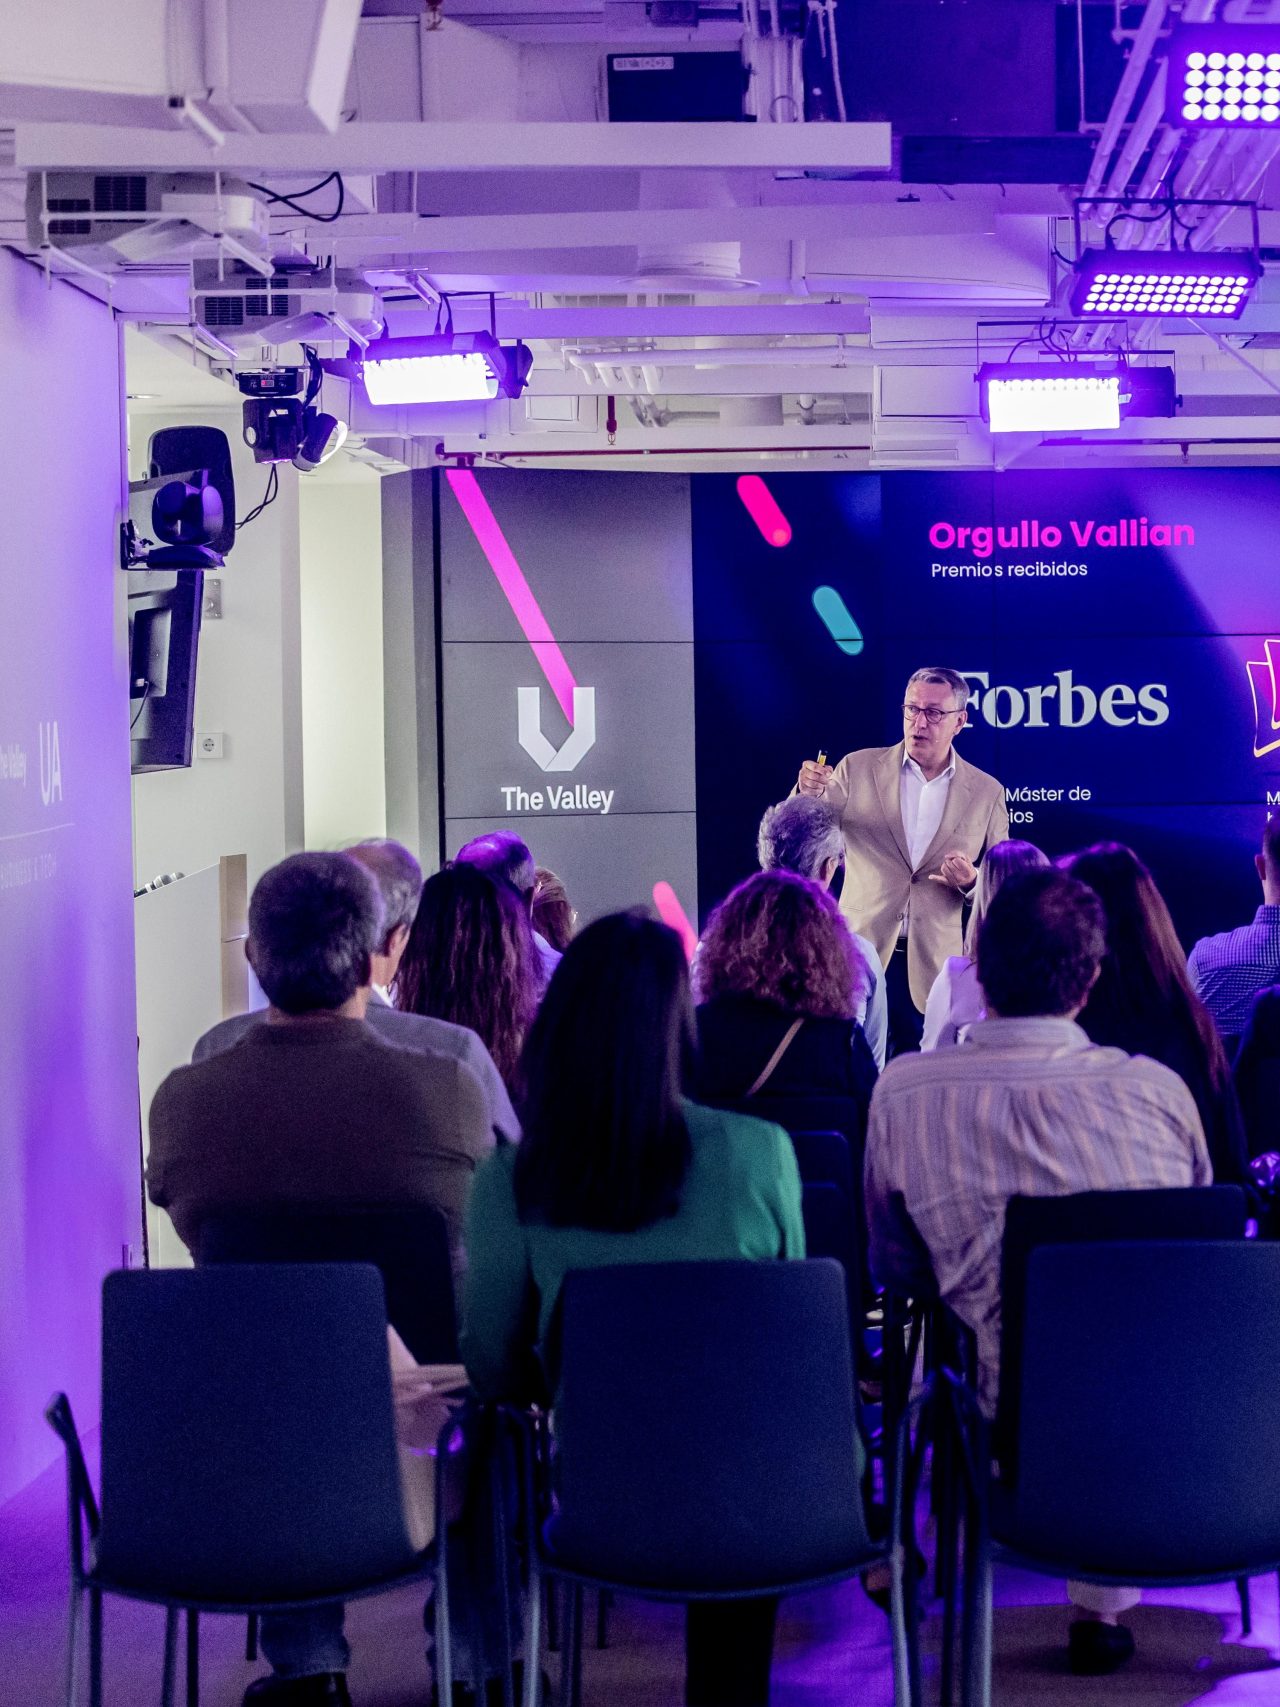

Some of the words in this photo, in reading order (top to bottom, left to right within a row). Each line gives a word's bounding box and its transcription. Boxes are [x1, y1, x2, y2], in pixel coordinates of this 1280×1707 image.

[928, 519, 1063, 558] Orgullo
[1069, 517, 1196, 547] Vallian
[931, 563, 1003, 577] Premios
[1007, 561, 1088, 577] recibidos
[501, 786, 544, 811] The
[546, 784, 615, 814] Valley
[1005, 786, 1064, 802] Máster
[1068, 786, 1092, 801] de
